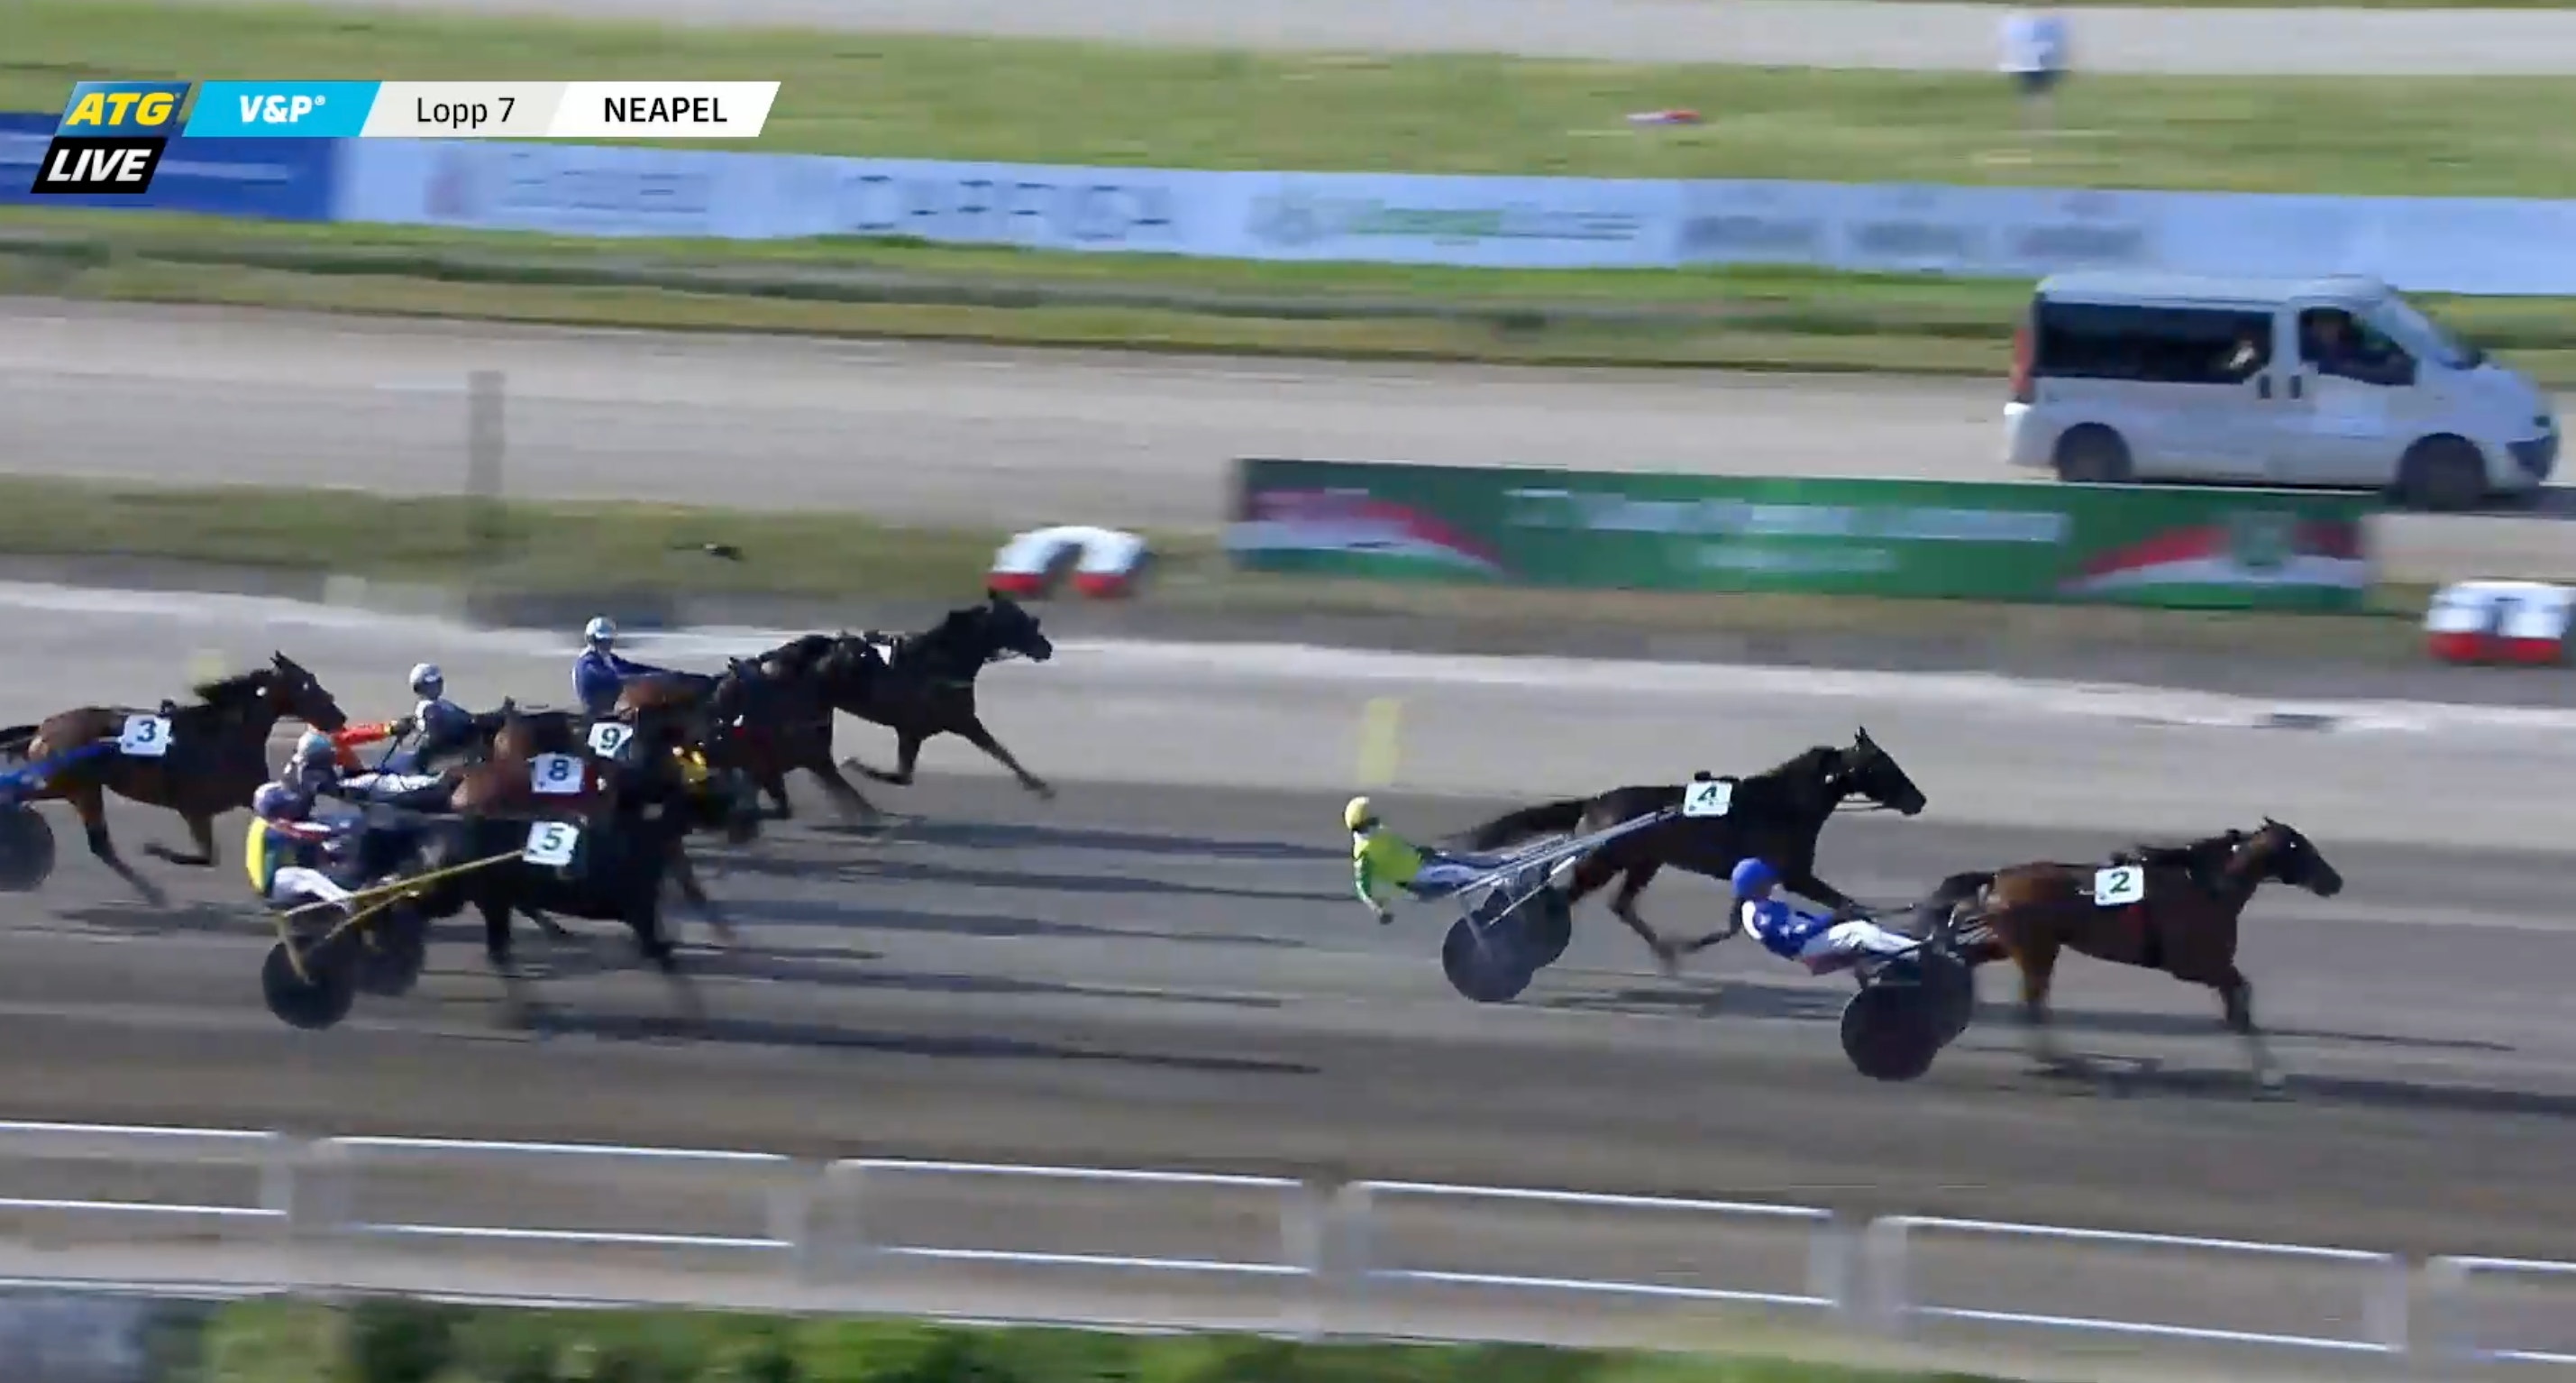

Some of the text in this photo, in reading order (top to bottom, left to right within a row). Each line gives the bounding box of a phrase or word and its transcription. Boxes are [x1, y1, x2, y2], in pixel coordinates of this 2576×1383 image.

[137, 720, 156, 742] 3
[600, 727, 620, 749] 9
[549, 759, 569, 781] 8
[1697, 784, 1718, 806] 4
[542, 827, 565, 850] 5
[2110, 871, 2131, 893] 2
